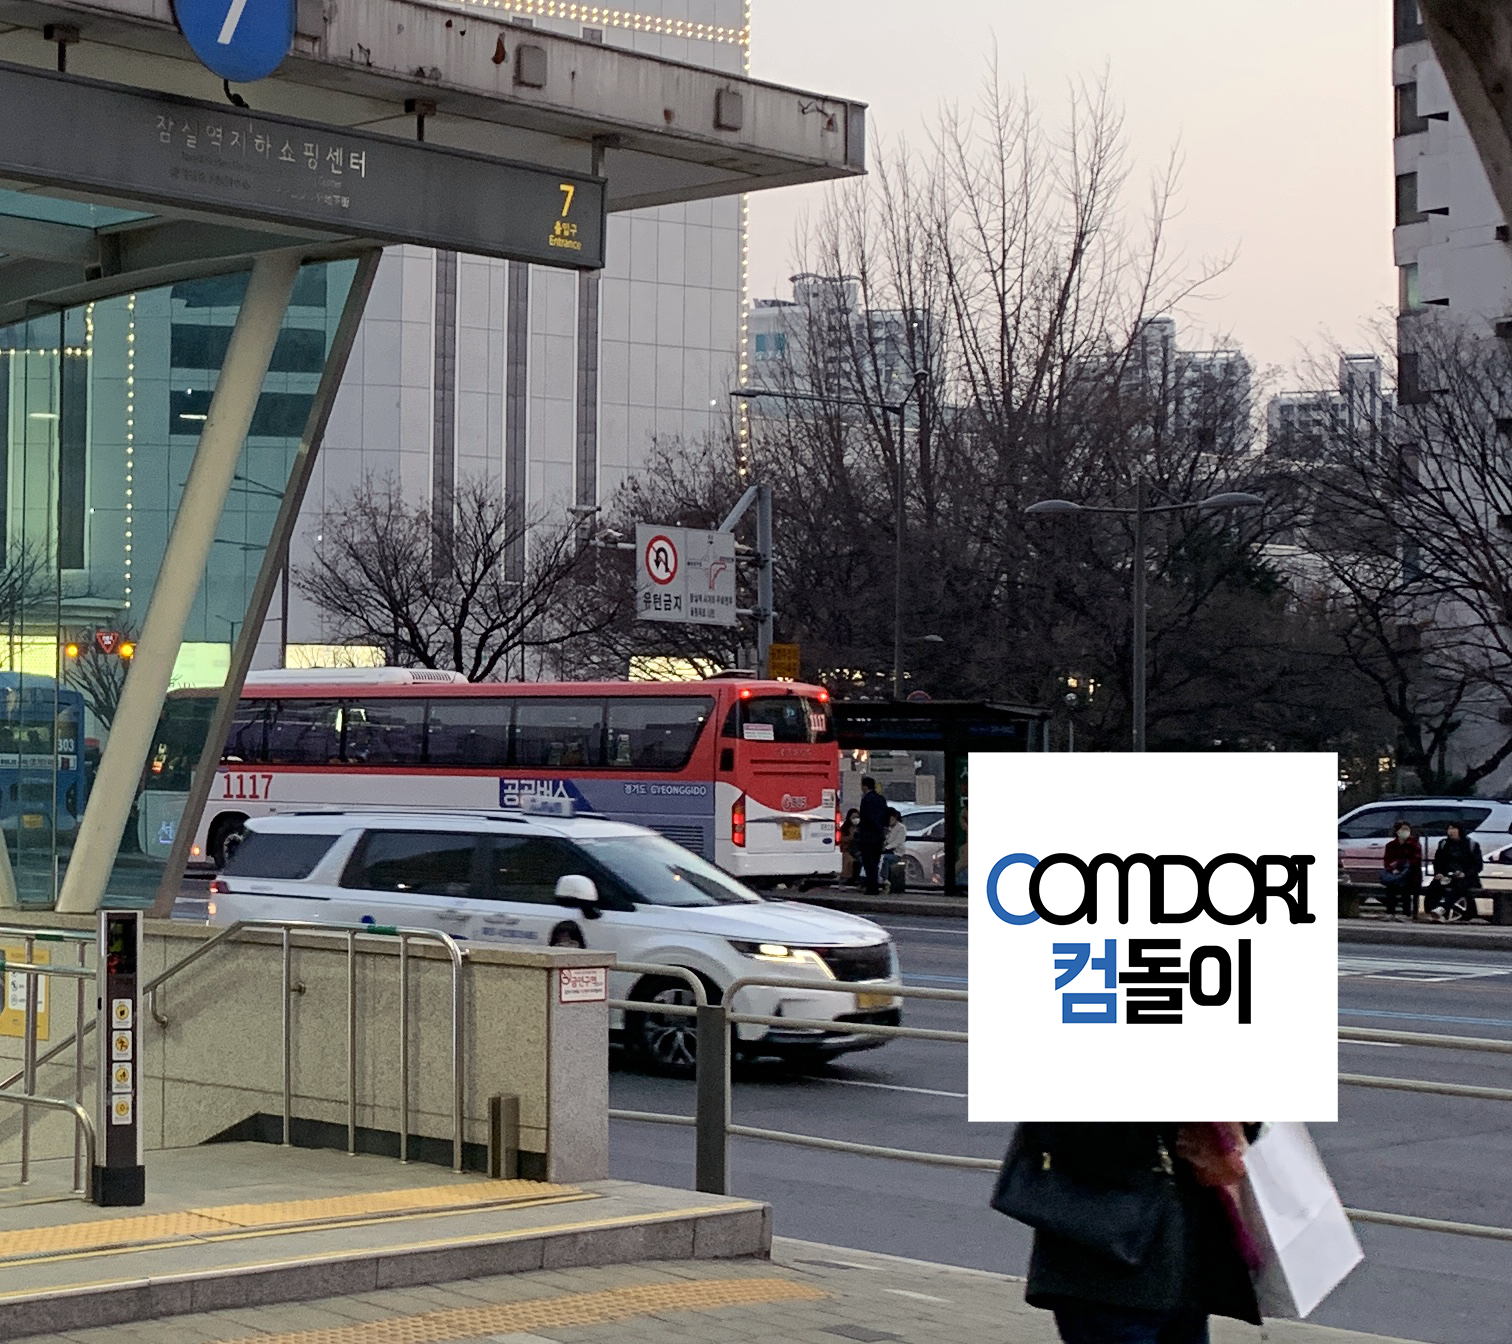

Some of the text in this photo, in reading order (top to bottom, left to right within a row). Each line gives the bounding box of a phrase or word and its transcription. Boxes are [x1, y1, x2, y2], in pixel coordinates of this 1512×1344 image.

[559, 183, 575, 217] 7
[642, 591, 682, 613] 유턴금지
[223, 773, 273, 799] 1117
[624, 783, 707, 796] 경기도 GYEONGGIDO
